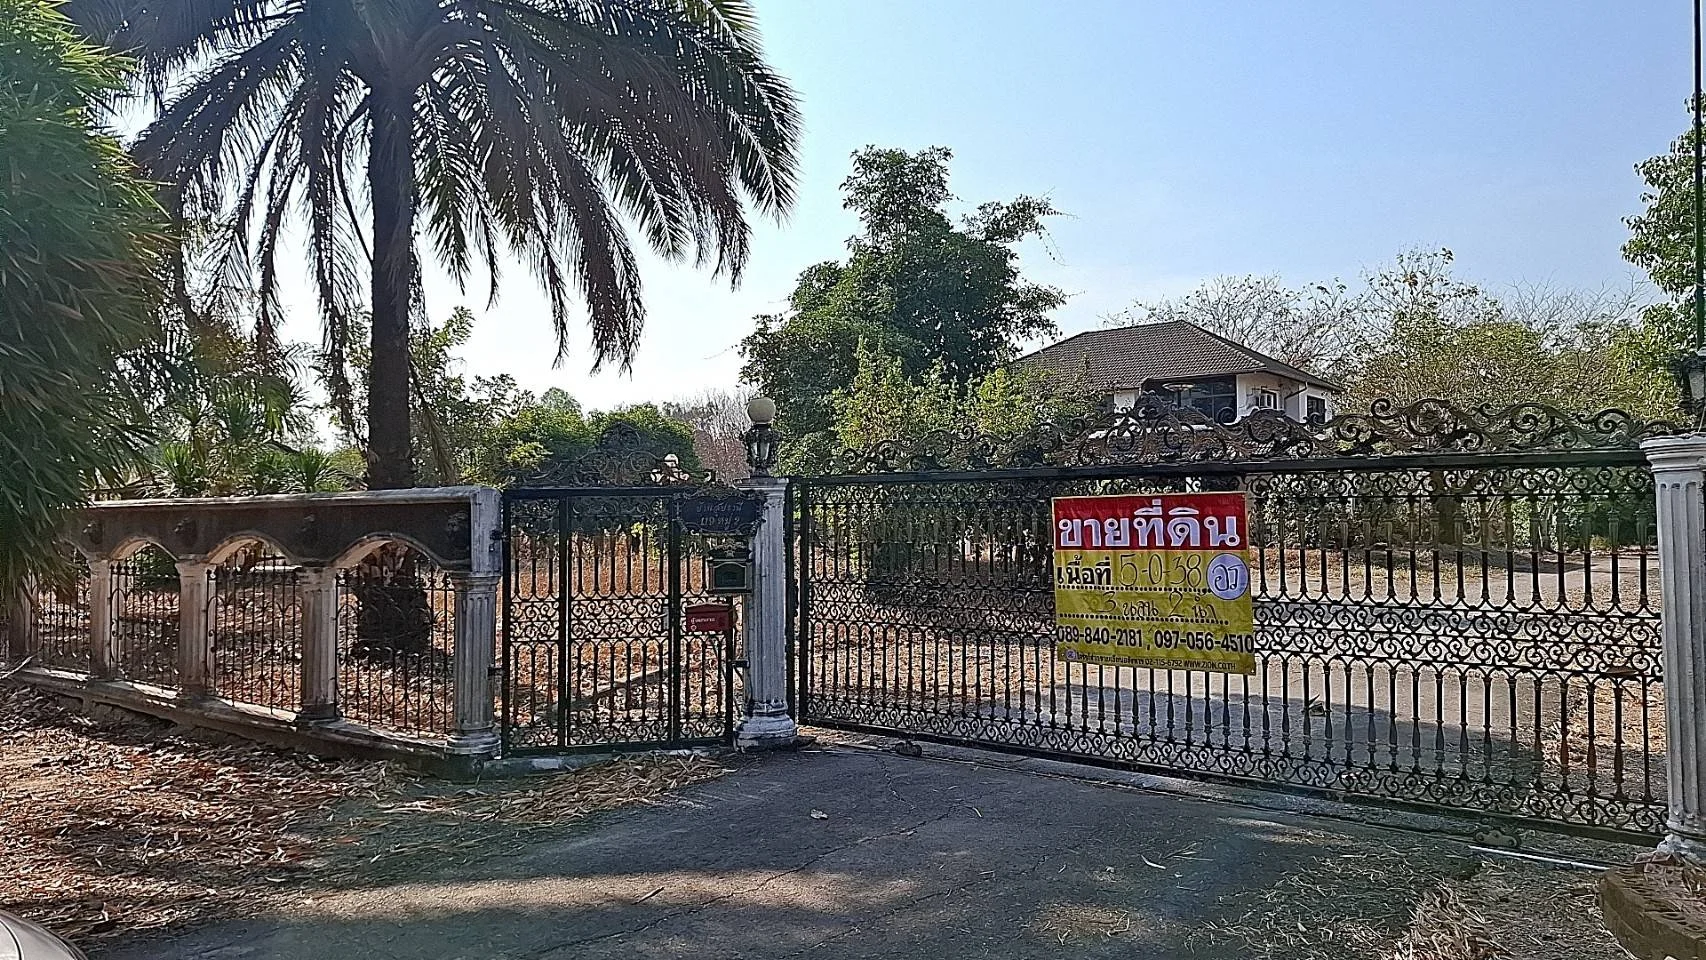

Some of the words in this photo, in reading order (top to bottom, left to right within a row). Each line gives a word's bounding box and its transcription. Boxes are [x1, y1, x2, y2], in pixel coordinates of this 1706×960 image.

[1058, 498, 1241, 547] ขายที่ดิน
[1057, 554, 1112, 586] เนื้อที่
[1119, 553, 1203, 588] 5-0-38
[1097, 590, 1117, 613] 3
[1168, 590, 1185, 619] 2
[1154, 631, 1256, 654] 097-056-4510
